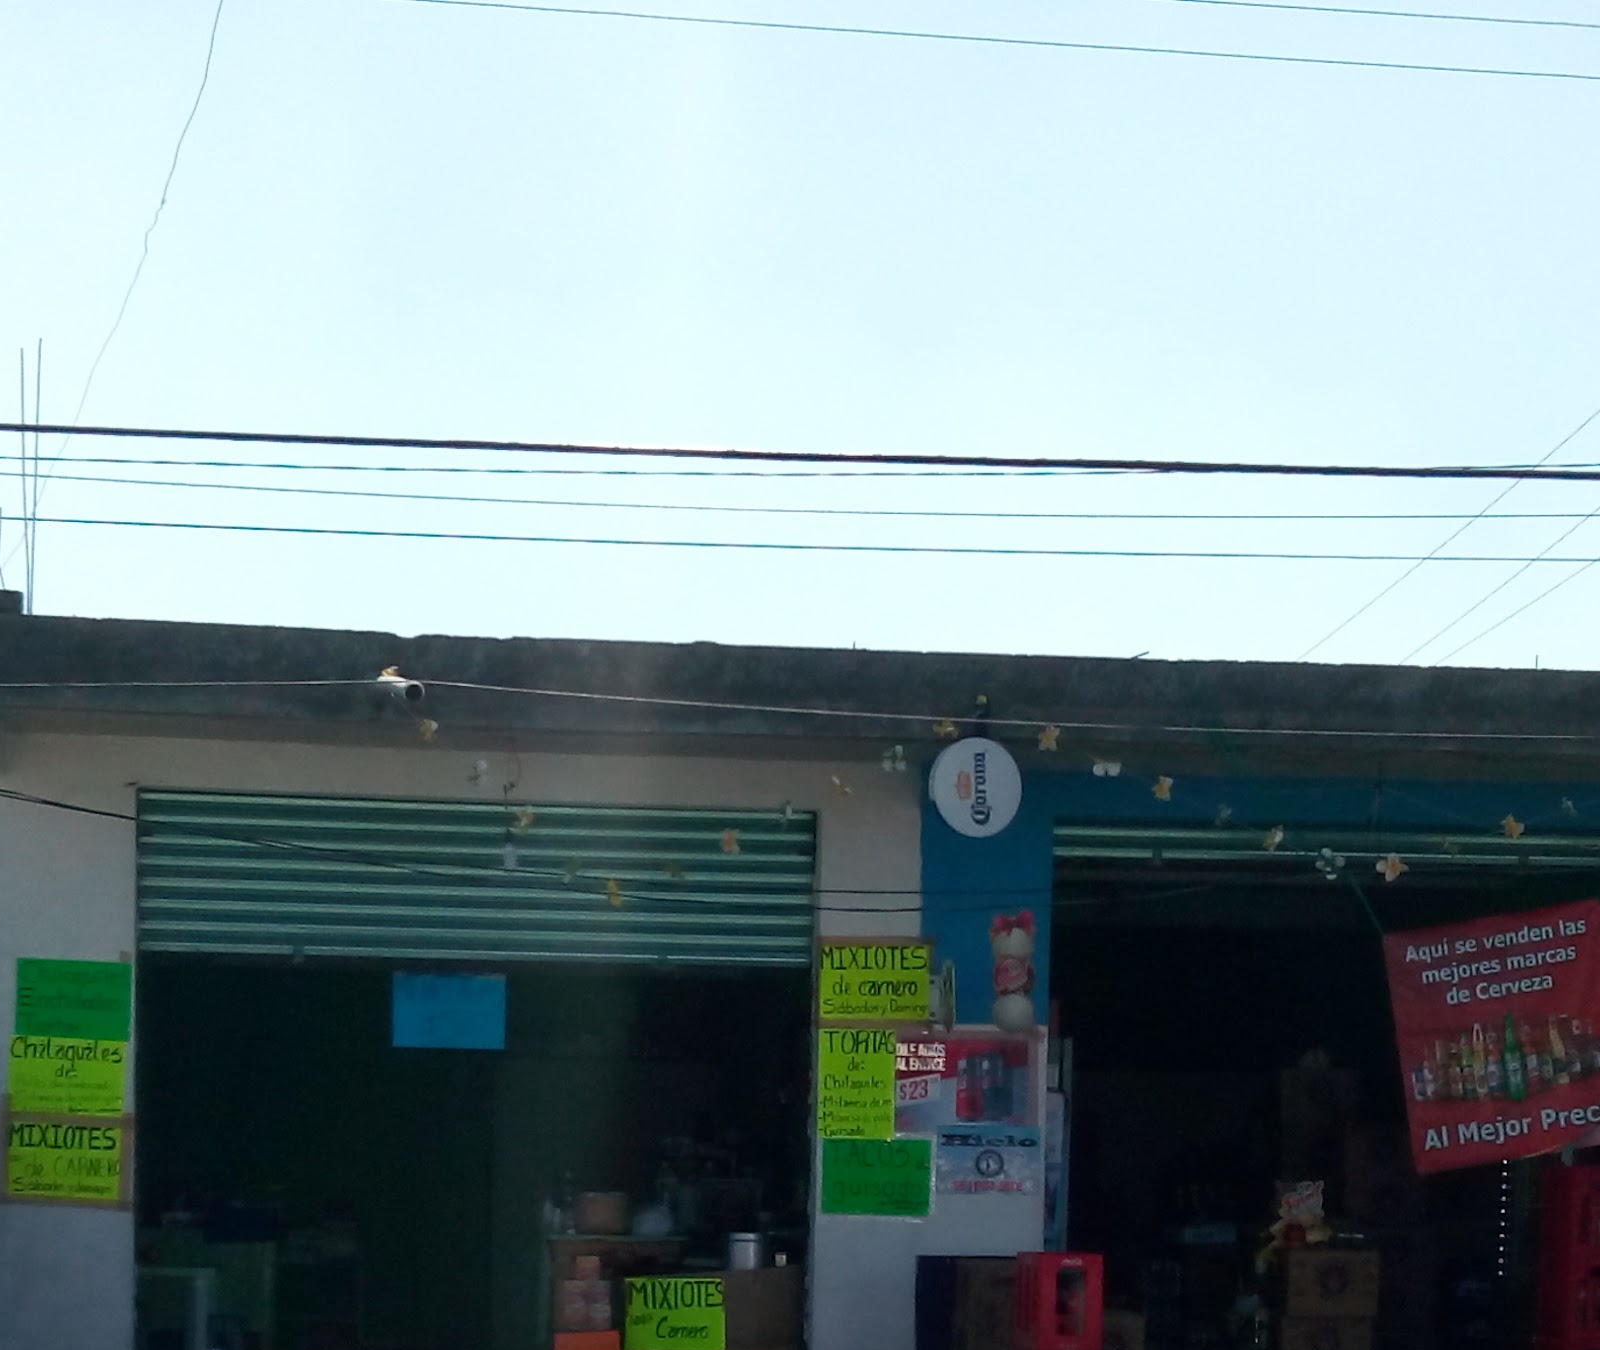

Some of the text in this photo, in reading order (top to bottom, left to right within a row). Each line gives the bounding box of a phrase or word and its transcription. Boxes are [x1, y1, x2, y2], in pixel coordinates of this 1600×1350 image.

[970, 752, 993, 825] Corona
[1405, 919, 1587, 963] Aquí se venden las
[821, 946, 927, 971] MIXIOTES
[1421, 945, 1577, 984] mejores marcas
[832, 974, 852, 996] de
[1445, 974, 1554, 1005] de Cerveza
[11, 1036, 123, 1064] Chilaquiles
[824, 1030, 896, 1054] TORTAS
[8, 1123, 117, 1150] MIXIOTES
[1424, 1125, 1449, 1151] Al
[1457, 1115, 1533, 1145] Mejor
